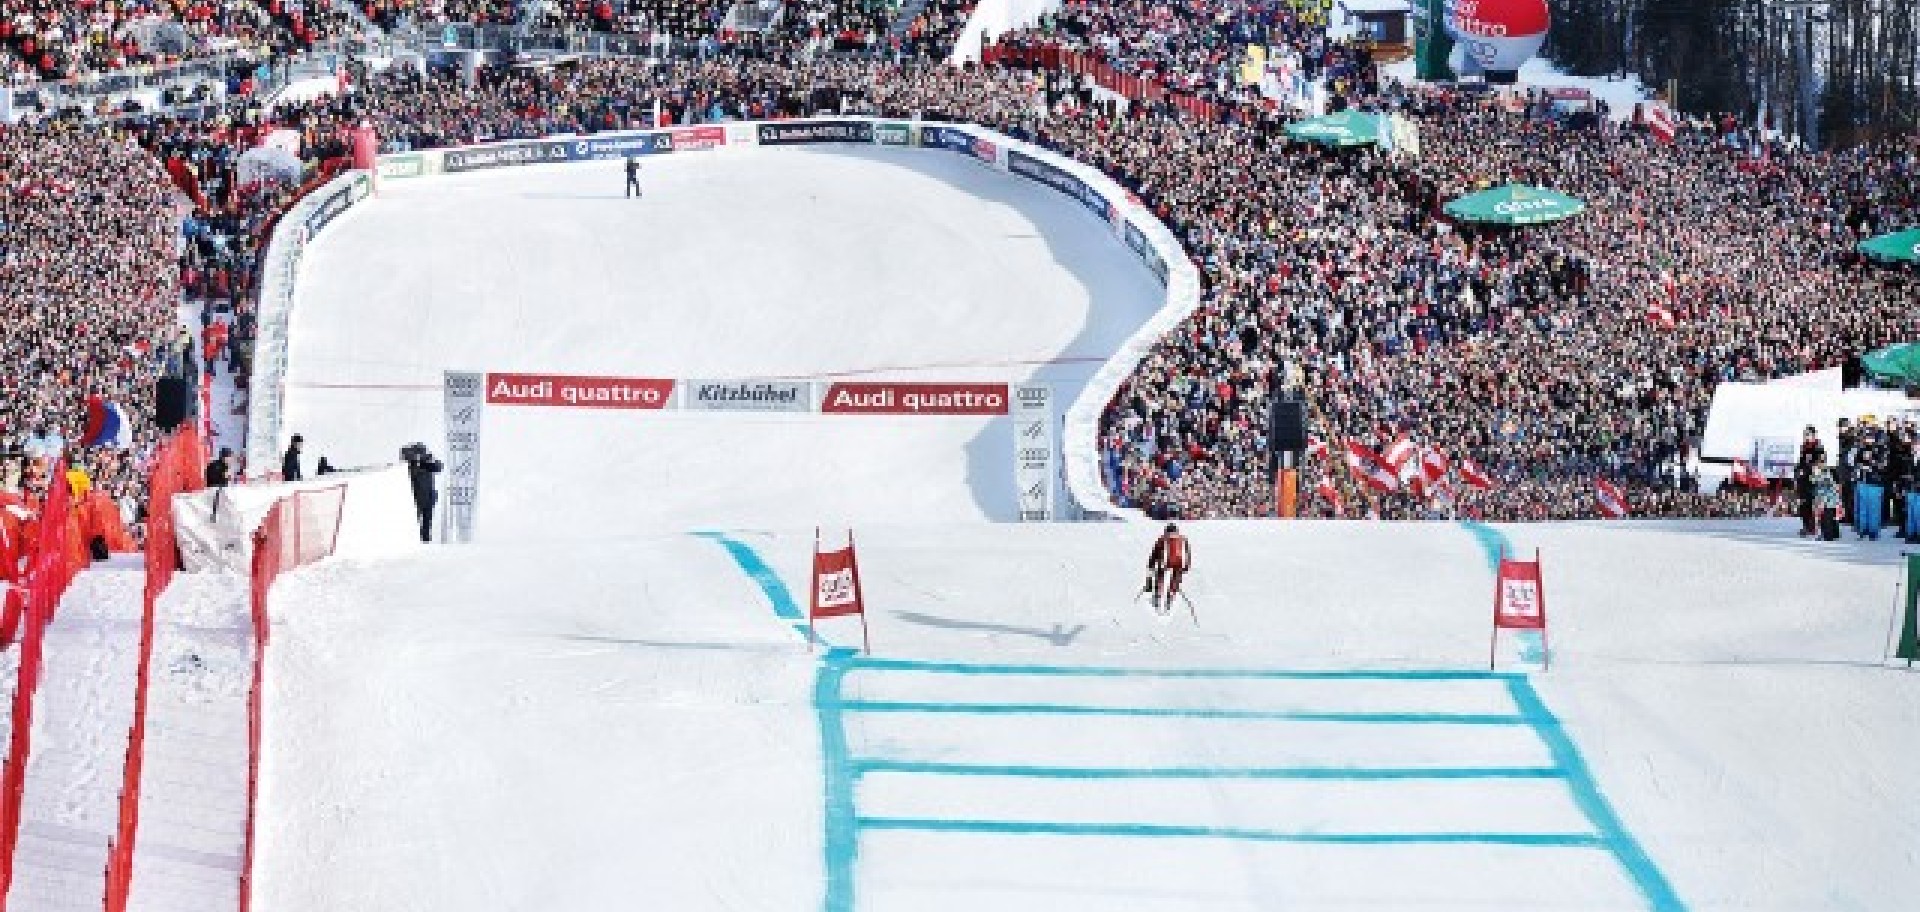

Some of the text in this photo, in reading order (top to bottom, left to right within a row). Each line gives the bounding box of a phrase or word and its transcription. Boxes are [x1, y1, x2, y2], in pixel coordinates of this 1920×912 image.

[491, 378, 661, 404] Audi quattro
[699, 384, 799, 403] Kitzbühel
[833, 387, 1003, 410] Audi quattro
